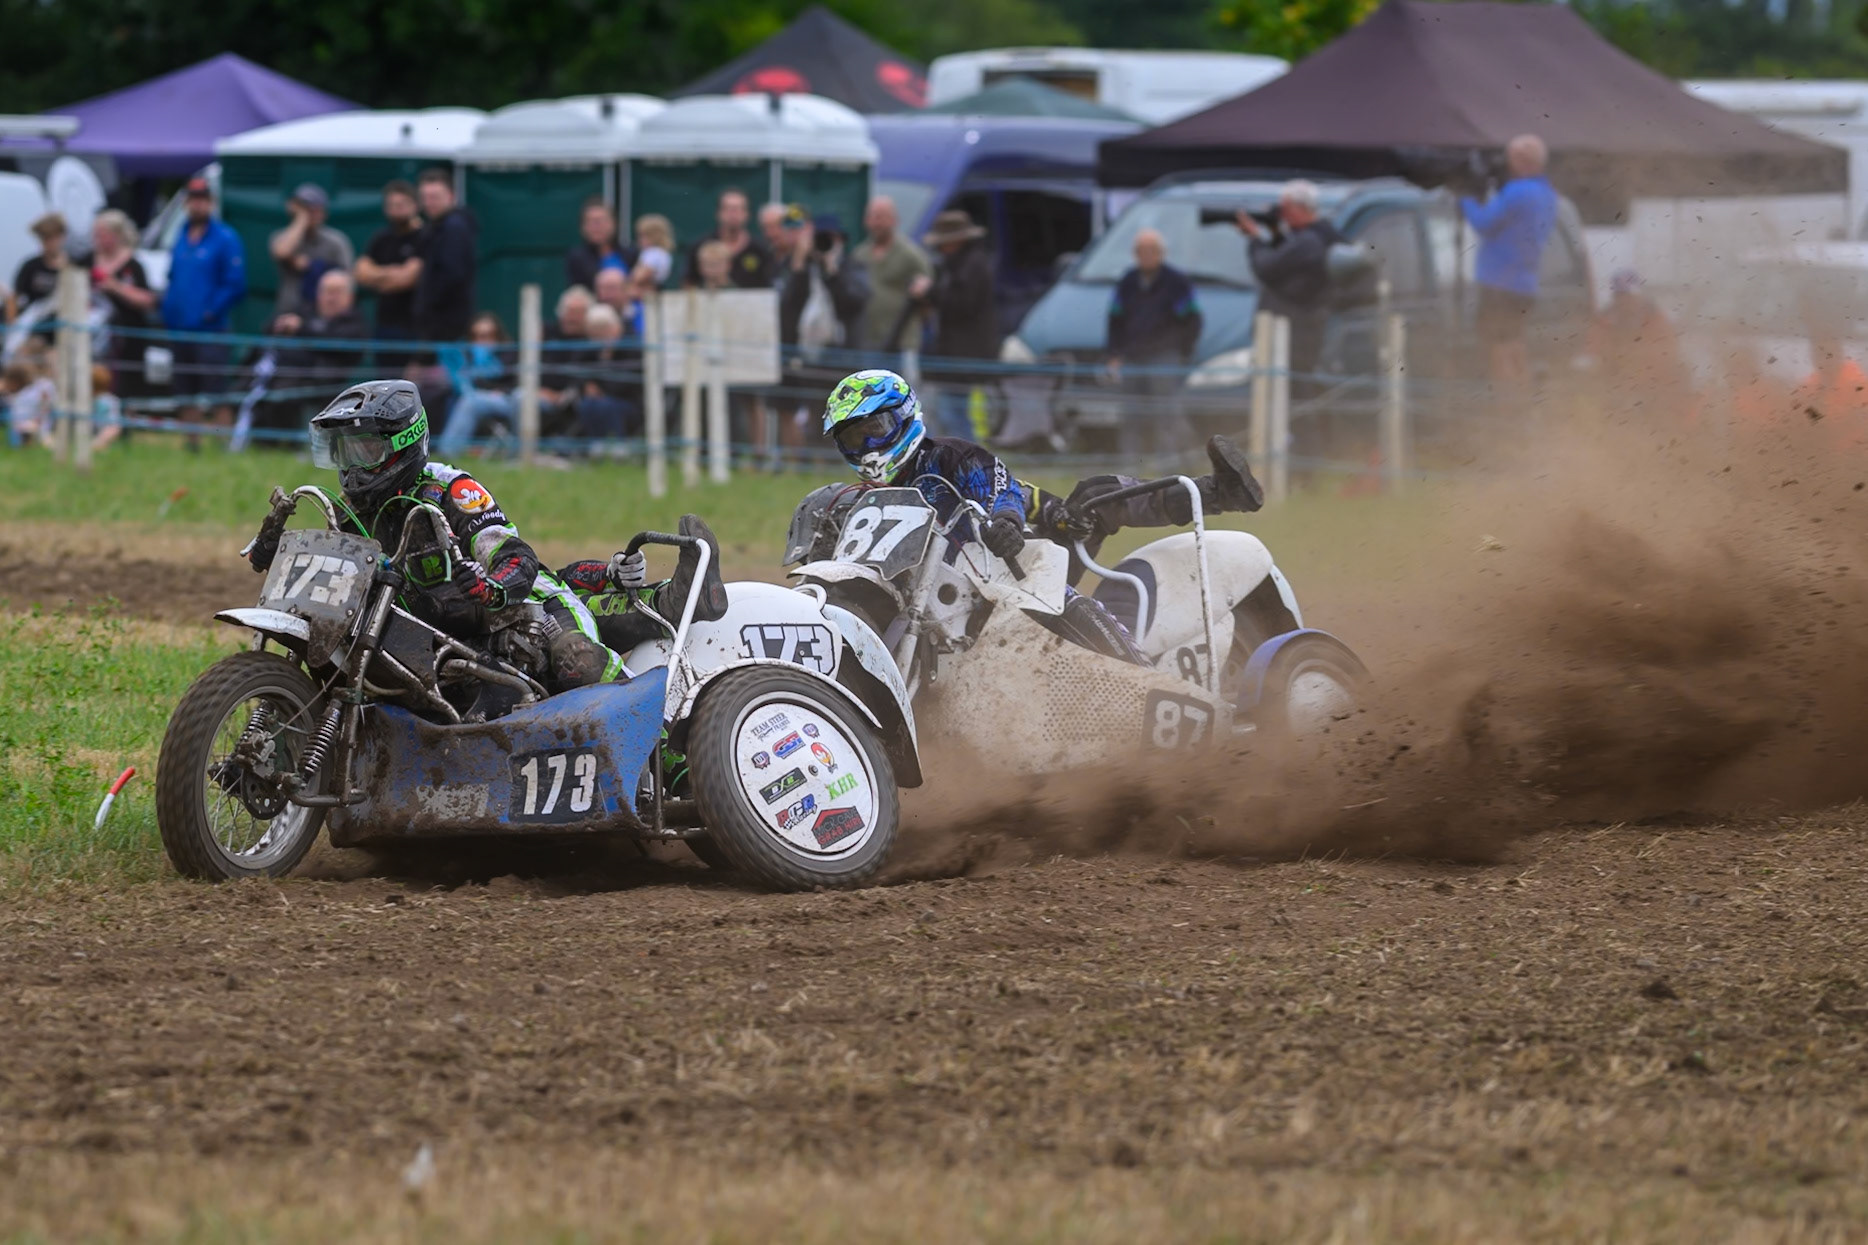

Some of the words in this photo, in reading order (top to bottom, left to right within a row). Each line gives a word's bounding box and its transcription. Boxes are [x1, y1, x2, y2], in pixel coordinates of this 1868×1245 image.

[833, 503, 929, 564] 87
[268, 553, 360, 606] 173
[740, 623, 836, 678] 173
[751, 721, 770, 737] TEAM
[1152, 699, 1209, 750] 87
[519, 752, 598, 816] 173
